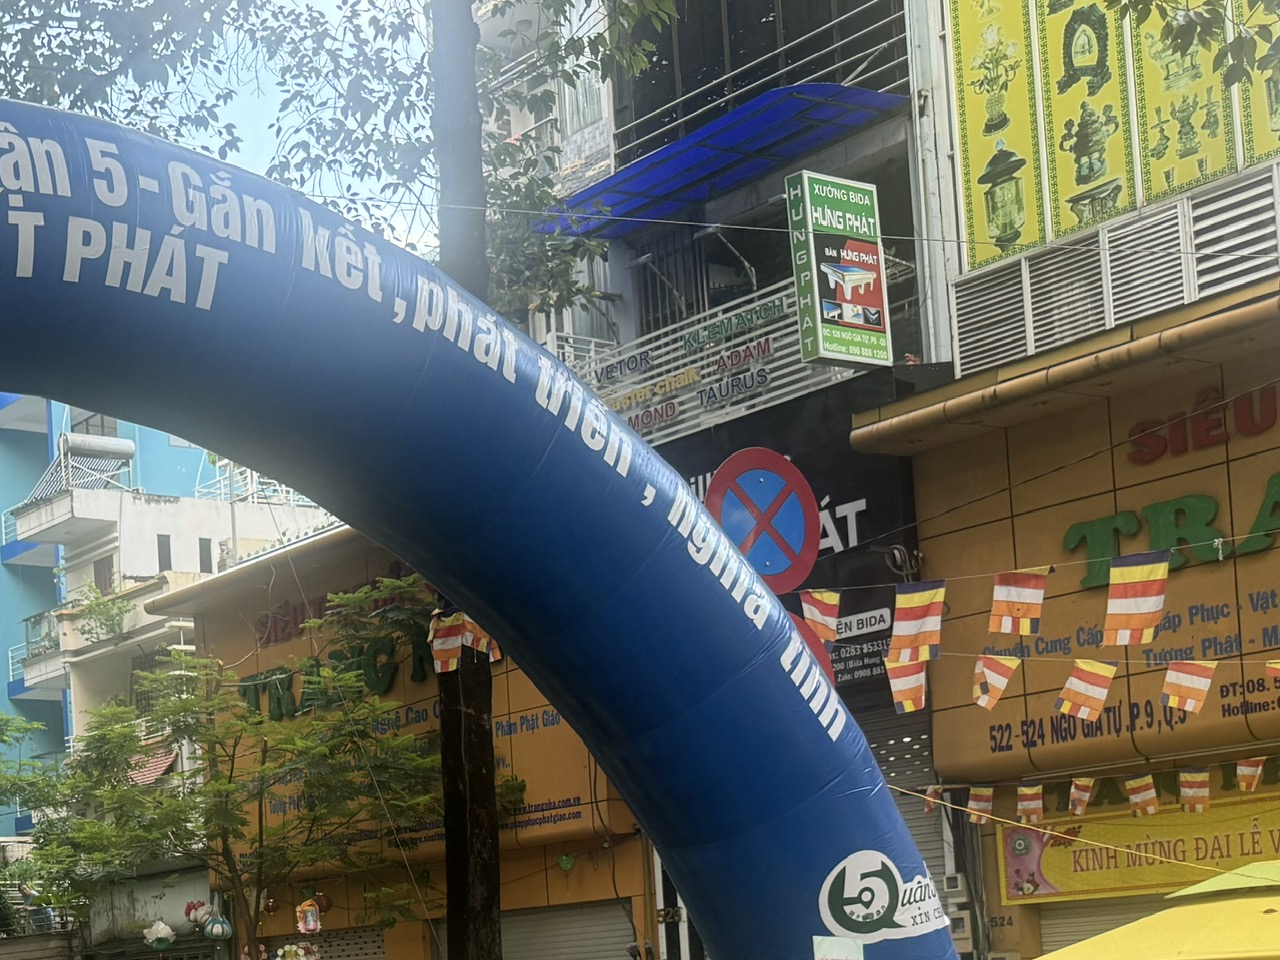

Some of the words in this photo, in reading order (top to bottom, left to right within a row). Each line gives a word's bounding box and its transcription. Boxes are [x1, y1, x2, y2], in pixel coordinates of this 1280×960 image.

[849, 191, 871, 206] BIDA
[812, 204, 844, 230] HƯNG
[845, 212, 875, 236] PHÁT
[61, 214, 229, 311] PHÁT
[800, 271, 815, 352] PHÁT
[594, 350, 651, 385] VETOR
[715, 338, 772, 374] ADAM
[696, 368, 768, 406] TAURUS
[627, 401, 676, 430] MOND
[856, 613, 886, 631] BIDA
[1035, 633, 1071, 656] Cung
[1248, 590, 1278, 615] Vật
[1194, 831, 1231, 867] ĐẠI
[1239, 816, 1263, 856] LỄ
[990, 916, 1014, 928] 524
